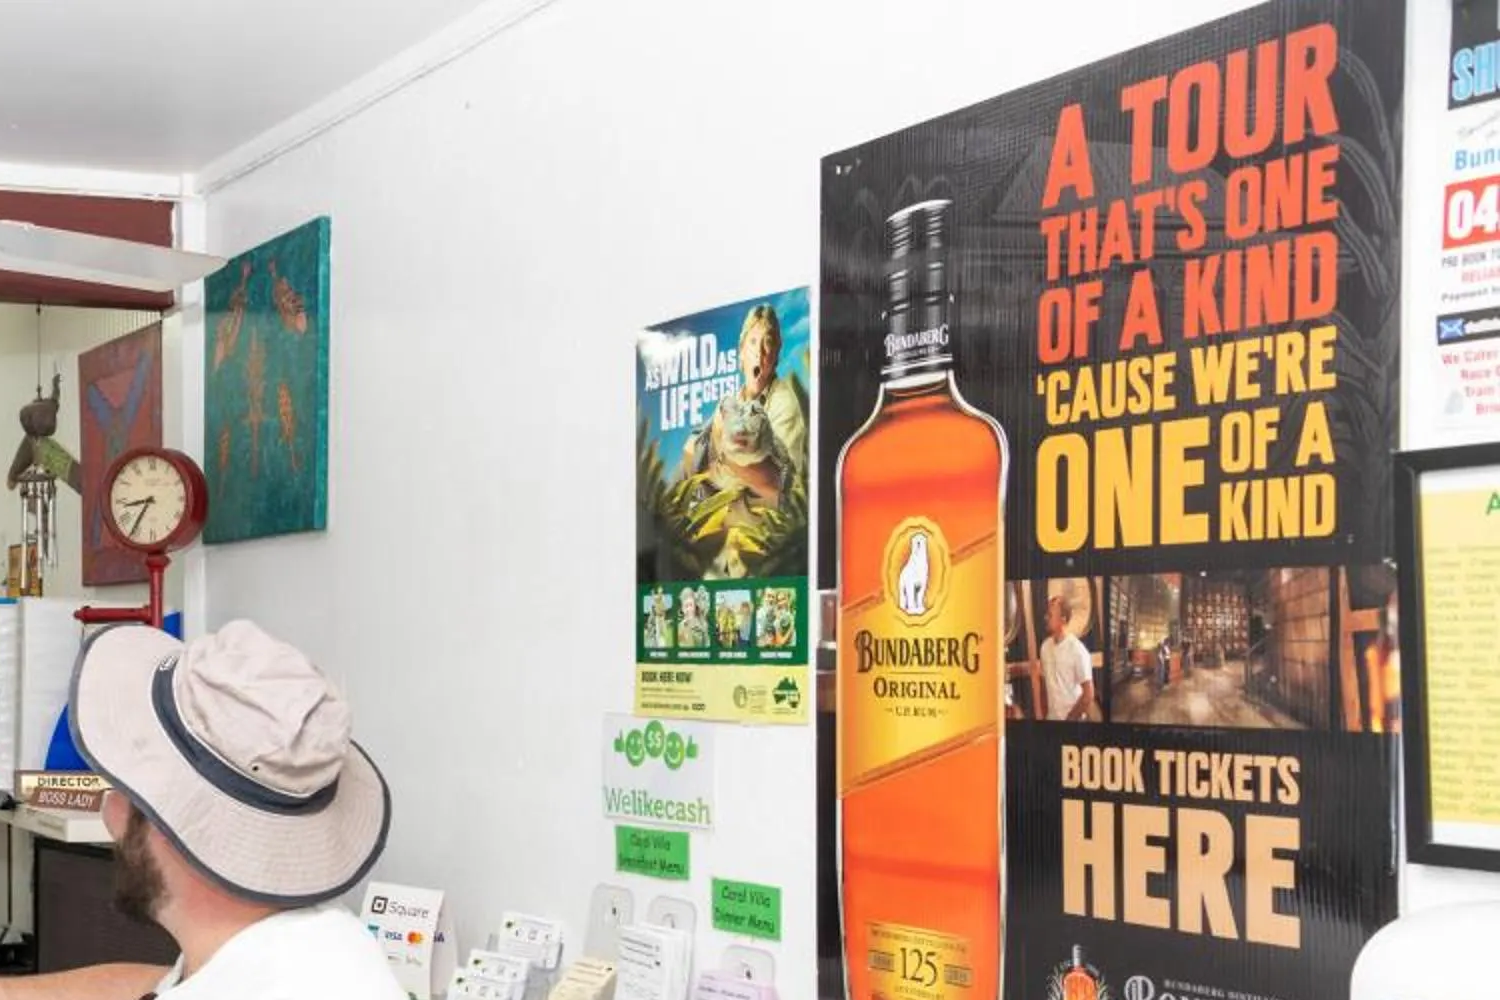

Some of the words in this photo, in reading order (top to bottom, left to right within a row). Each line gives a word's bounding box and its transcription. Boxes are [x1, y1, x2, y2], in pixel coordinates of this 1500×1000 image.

[1452, 39, 1500, 101] SH
[1042, 104, 1094, 209] A
[1121, 22, 1340, 185] TOUR
[1455, 149, 1500, 170] Bun
[1040, 179, 1208, 281] THAT'S
[1225, 144, 1341, 241] ONE
[1461, 251, 1487, 266] BOOK
[1038, 281, 1103, 364] OF
[1119, 269, 1163, 351] A
[1184, 231, 1338, 339] KIND
[659, 333, 717, 387] WILD
[717, 349, 737, 374] AS
[884, 324, 948, 357] BUNDABERG
[1036, 351, 1177, 425] 'CAUSE
[1190, 325, 1338, 406] WE'RE
[661, 381, 703, 431] LIFE
[1036, 417, 1210, 553] ONE
[1220, 407, 1281, 473] OF
[1295, 401, 1336, 466] A
[1219, 473, 1336, 542] KIND
[855, 630, 980, 674] BUNDABERG
[873, 677, 960, 700] ORIGINAL
[1061, 745, 1145, 794] BOOK
[1155, 750, 1300, 806] TICKETS
[38, 790, 66, 805] BOSS
[67, 793, 97, 809] LADY
[602, 784, 712, 825] Welikecash
[721, 885, 746, 904] Coral
[1062, 799, 1301, 949] HERE
[389, 900, 429, 918] Square
[748, 914, 775, 933] Menu
[900, 947, 939, 988] 125
